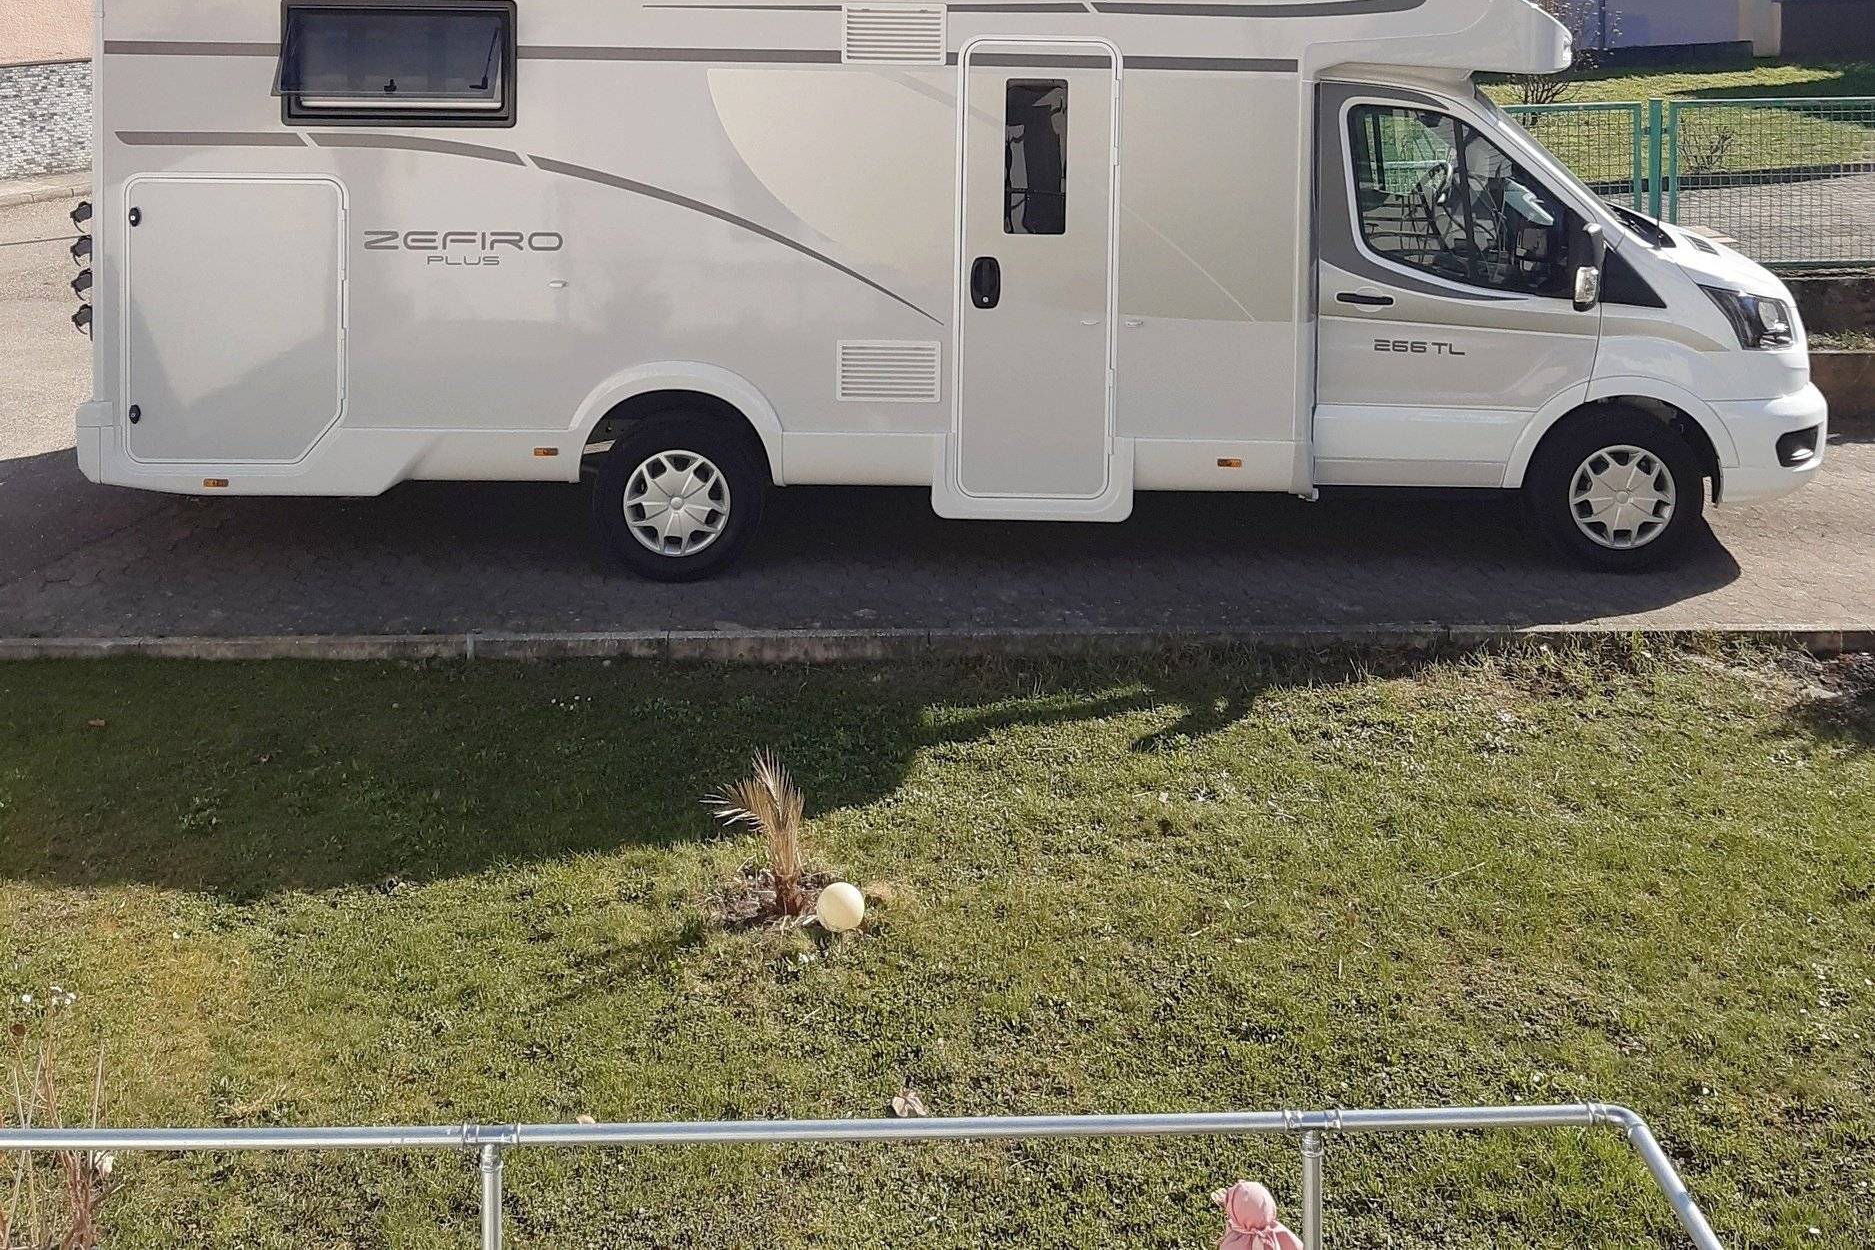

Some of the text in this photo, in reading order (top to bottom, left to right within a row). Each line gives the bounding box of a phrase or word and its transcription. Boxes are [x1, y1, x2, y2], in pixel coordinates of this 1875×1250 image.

[363, 230, 564, 251] ZEFIRO
[427, 255, 501, 266] PLUS
[1431, 341, 1466, 356] TL
